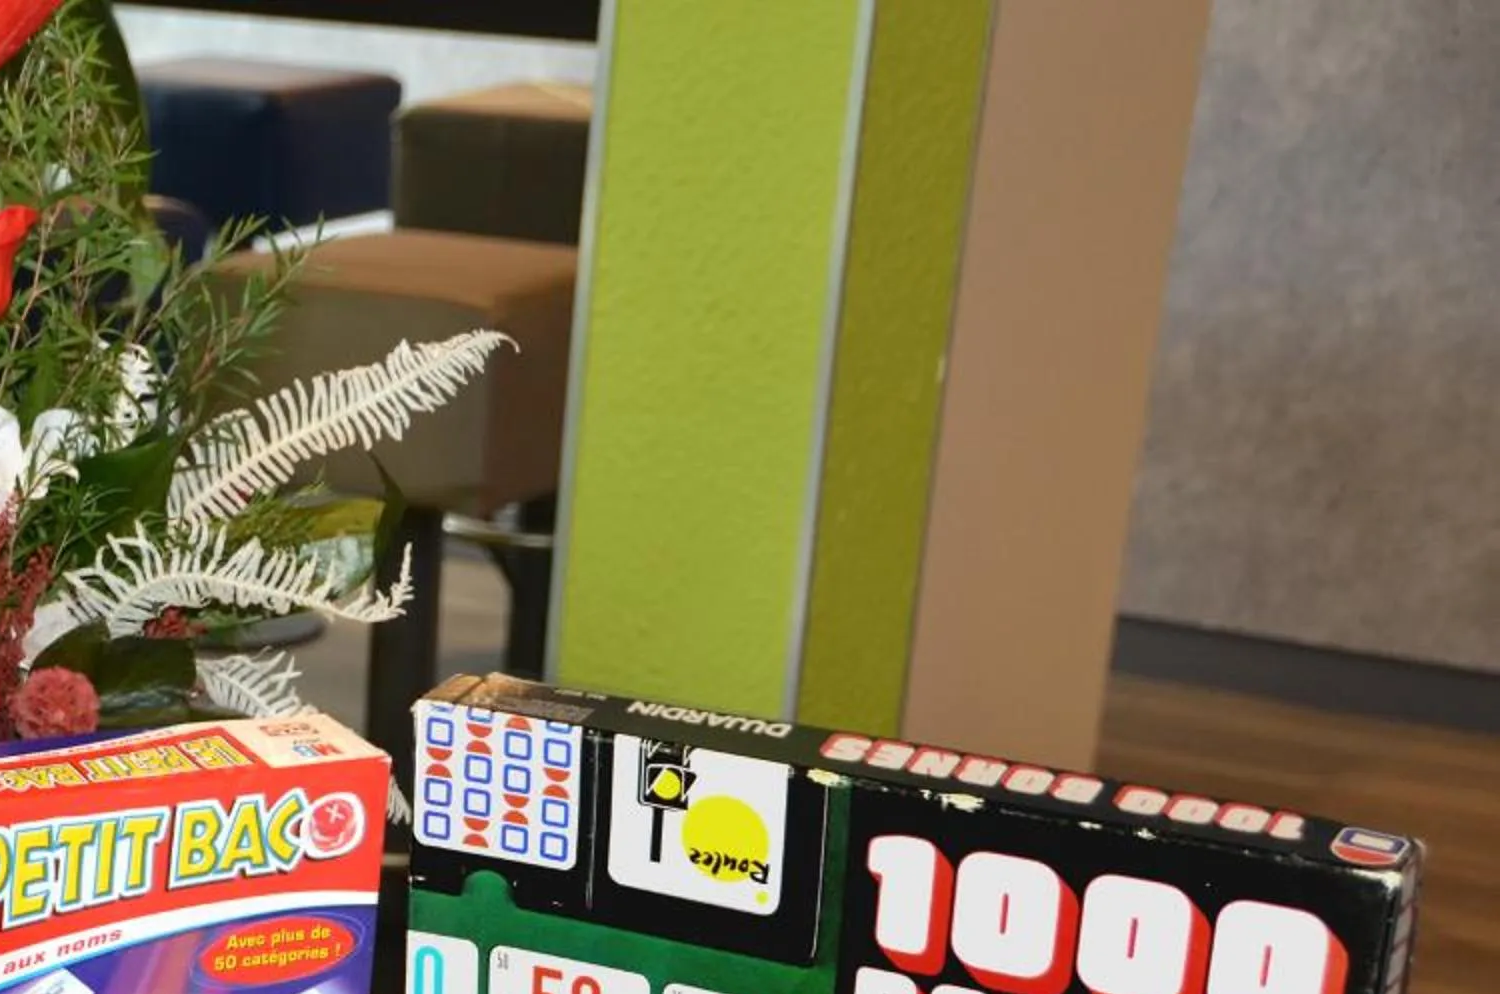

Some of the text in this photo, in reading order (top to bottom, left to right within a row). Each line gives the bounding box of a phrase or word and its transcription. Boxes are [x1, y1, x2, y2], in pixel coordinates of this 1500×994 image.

[626, 699, 792, 740] DUJARDIN
[818, 732, 1306, 843] 1000 BORNES
[173, 790, 306, 884] BAC
[688, 846, 771, 885] Roulez
[2, 950, 46, 977] aux
[56, 929, 123, 957] noms
[214, 954, 237, 971] 50
[241, 944, 329, 969] catégories
[226, 926, 331, 952] Avec plus de
